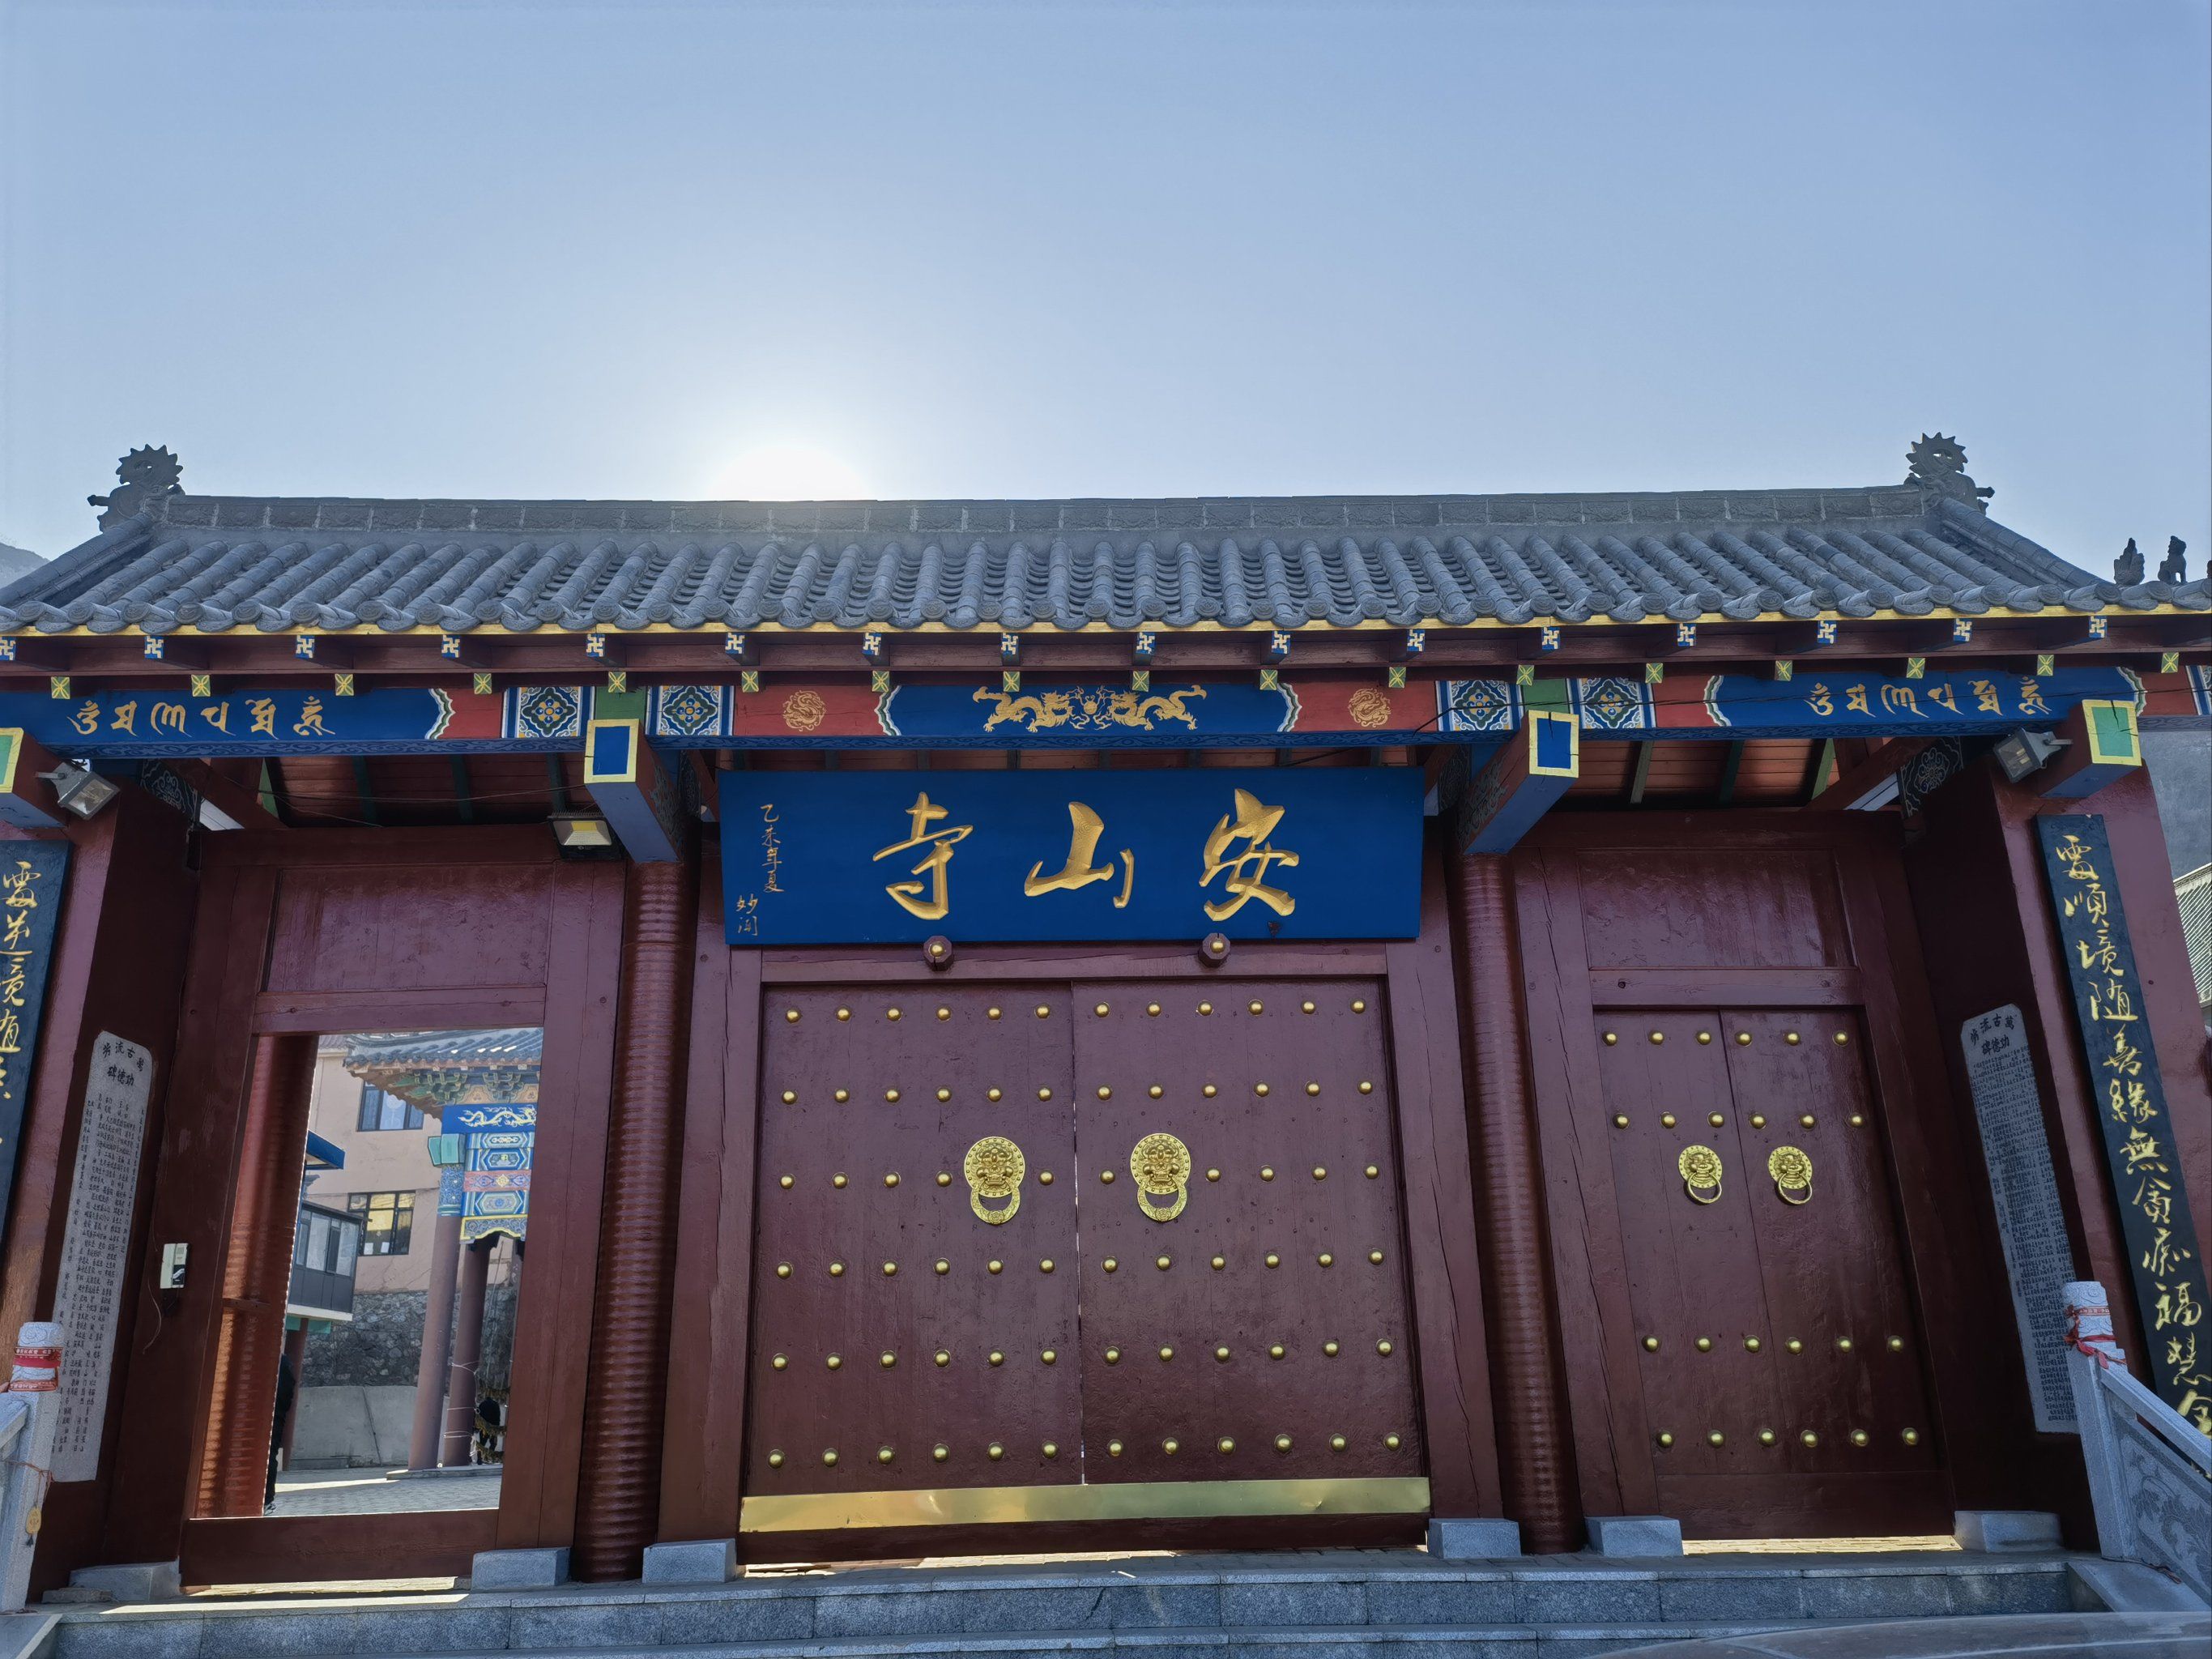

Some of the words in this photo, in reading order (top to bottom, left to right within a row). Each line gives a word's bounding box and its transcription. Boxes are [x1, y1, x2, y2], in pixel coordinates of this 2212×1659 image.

[872, 788, 1300, 922] 安山寺
[107, 1064, 134, 1086] 功德碑
